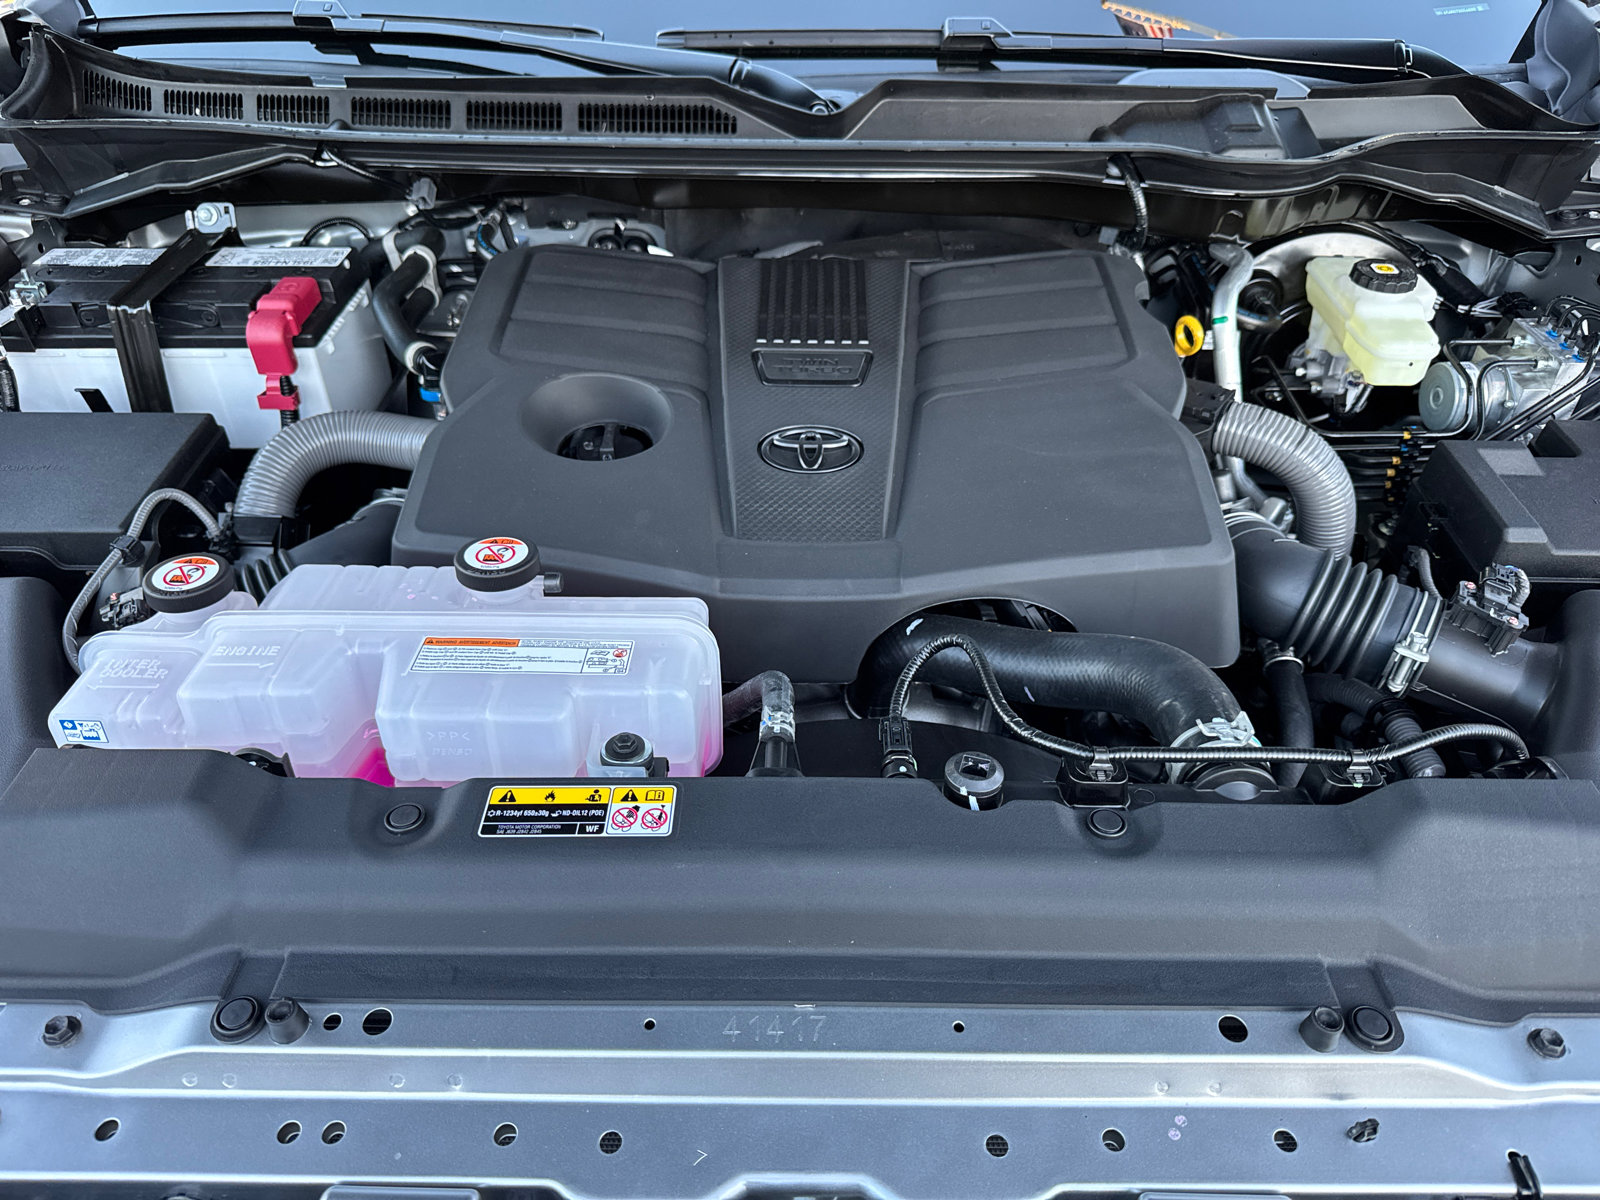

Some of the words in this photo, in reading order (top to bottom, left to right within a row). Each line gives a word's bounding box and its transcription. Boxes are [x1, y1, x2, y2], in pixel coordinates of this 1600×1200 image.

[782, 357, 839, 365] TWIN
[773, 365, 852, 374] TURBO
[211, 645, 281, 657] ENGINE
[105, 658, 161, 669] INTER
[99, 667, 169, 679] COOLER
[431, 747, 473, 757] DENSO
[496, 810, 523, 818] R-1234yf
[585, 824, 600, 833] WF
[721, 1014, 827, 1044] 41417
